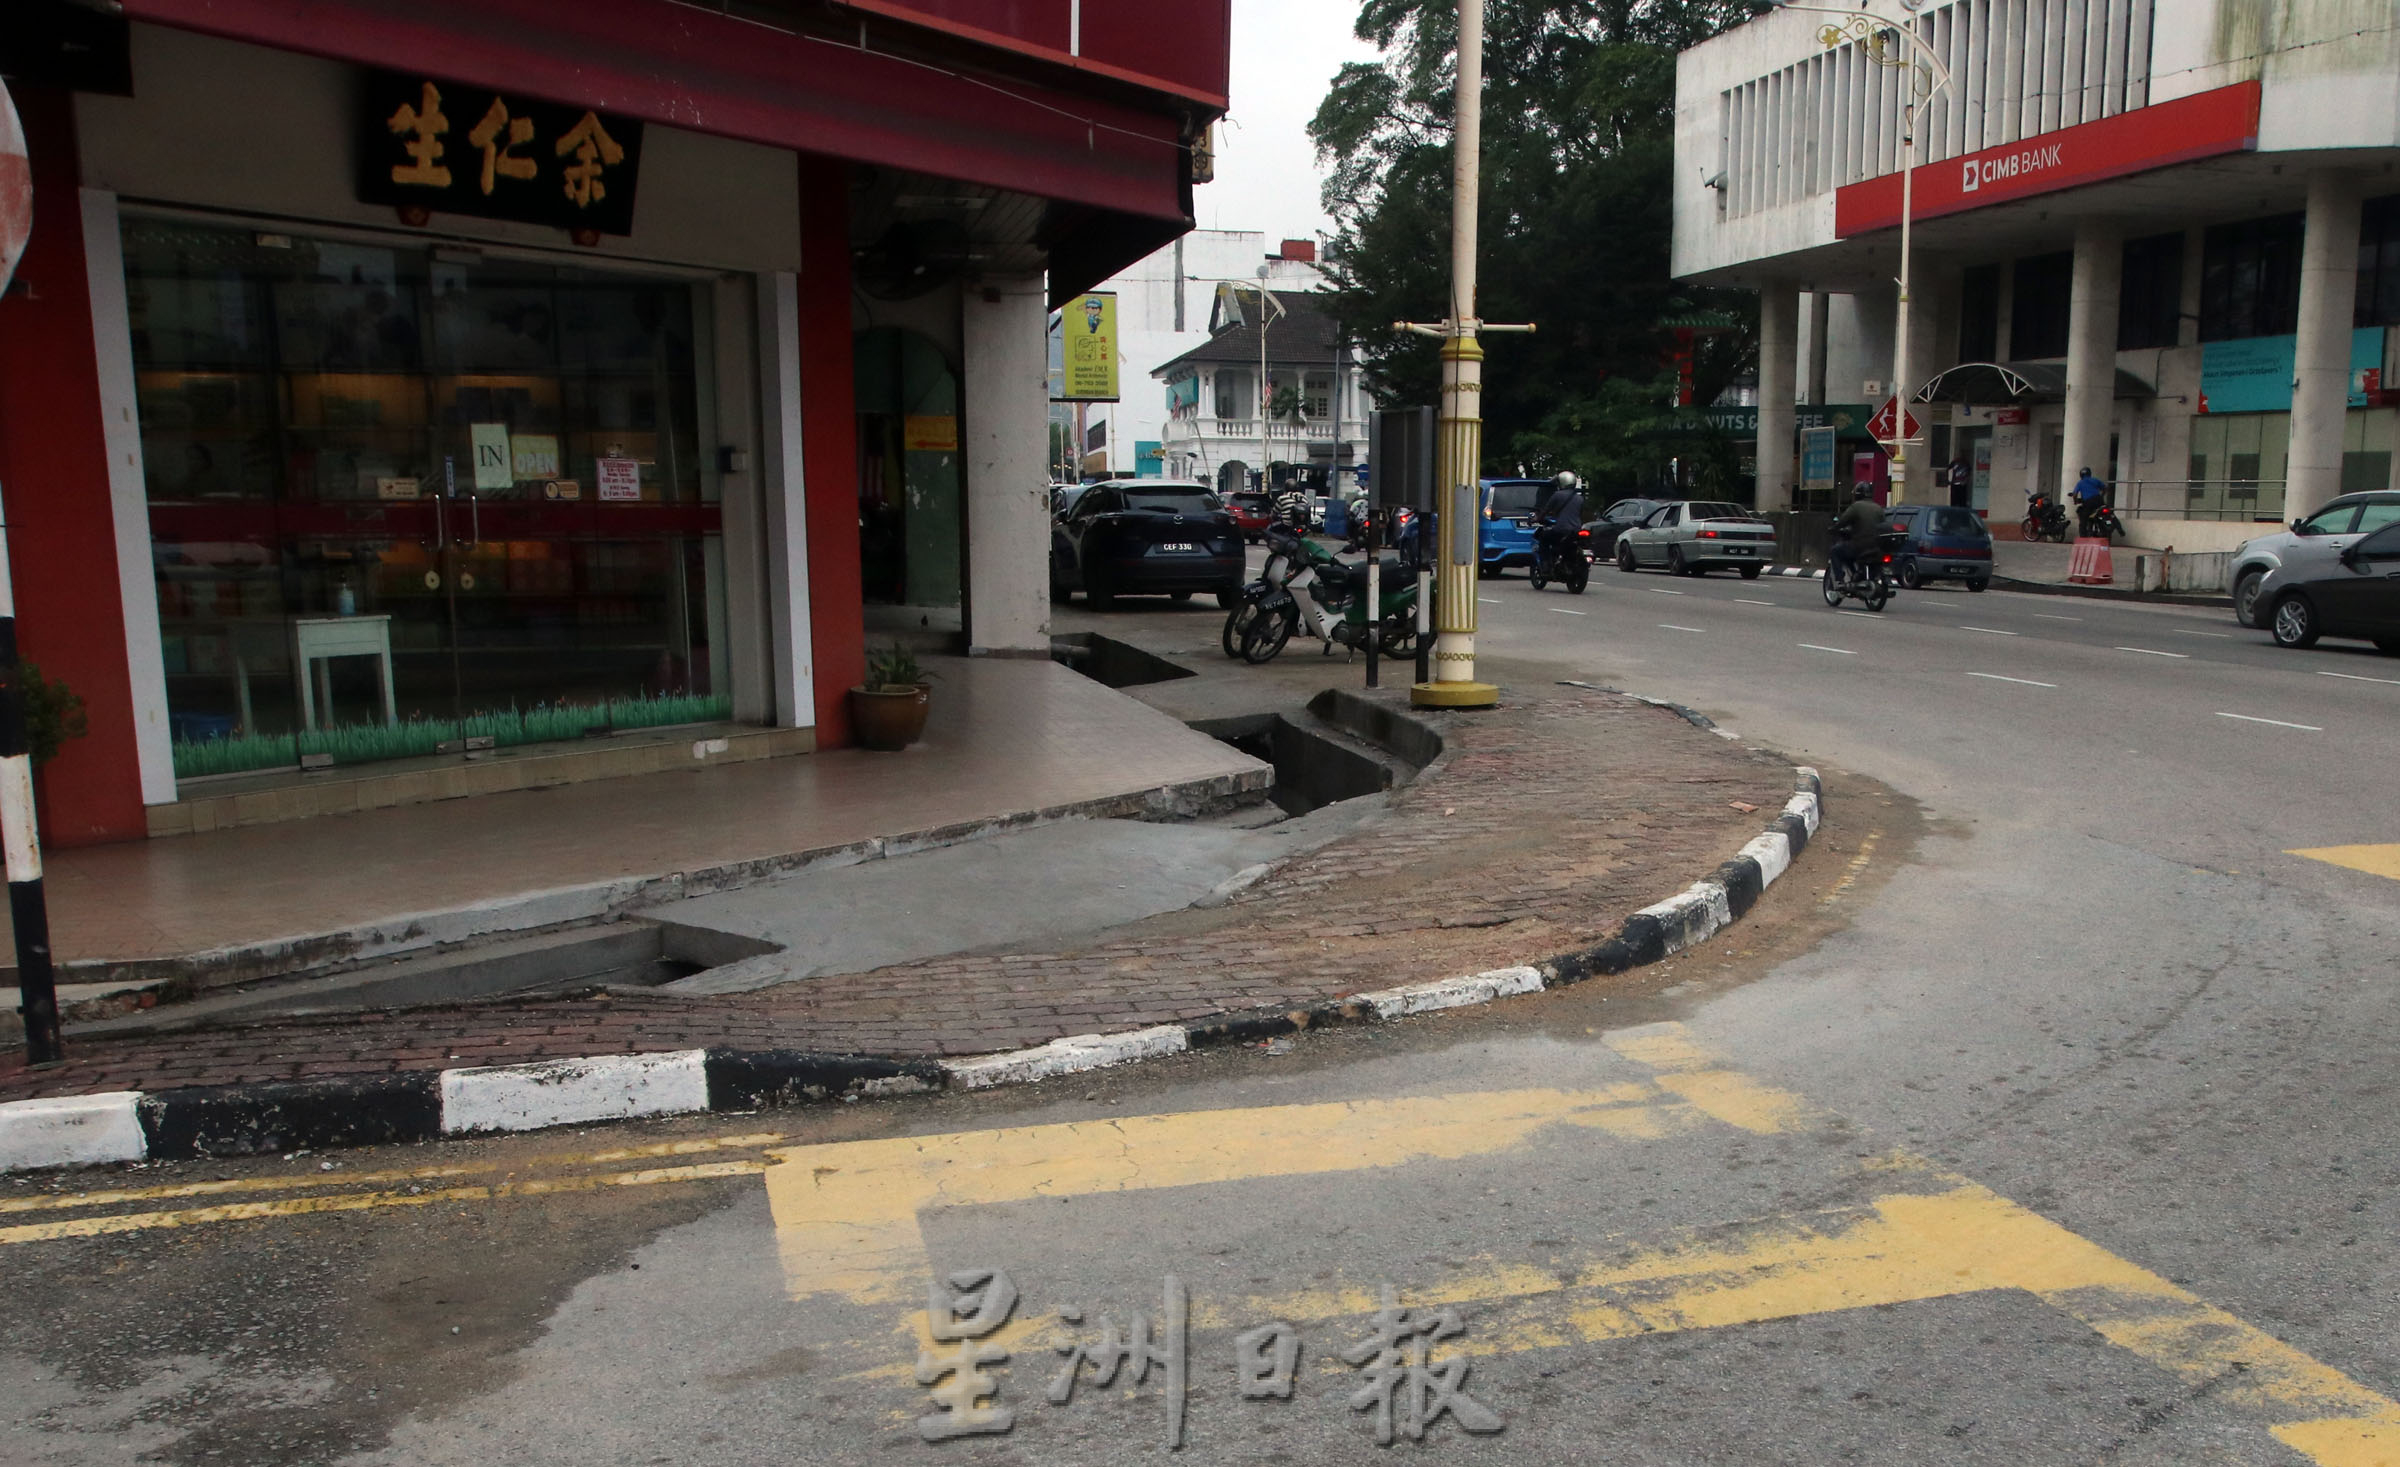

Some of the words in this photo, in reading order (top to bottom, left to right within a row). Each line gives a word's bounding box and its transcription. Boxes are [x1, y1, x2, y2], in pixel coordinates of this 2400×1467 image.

[1983, 155, 2019, 183] CIMB
[2021, 144, 2062, 174] BANK
[479, 445, 503, 467] IN
[516, 453, 556, 474] OPEN
